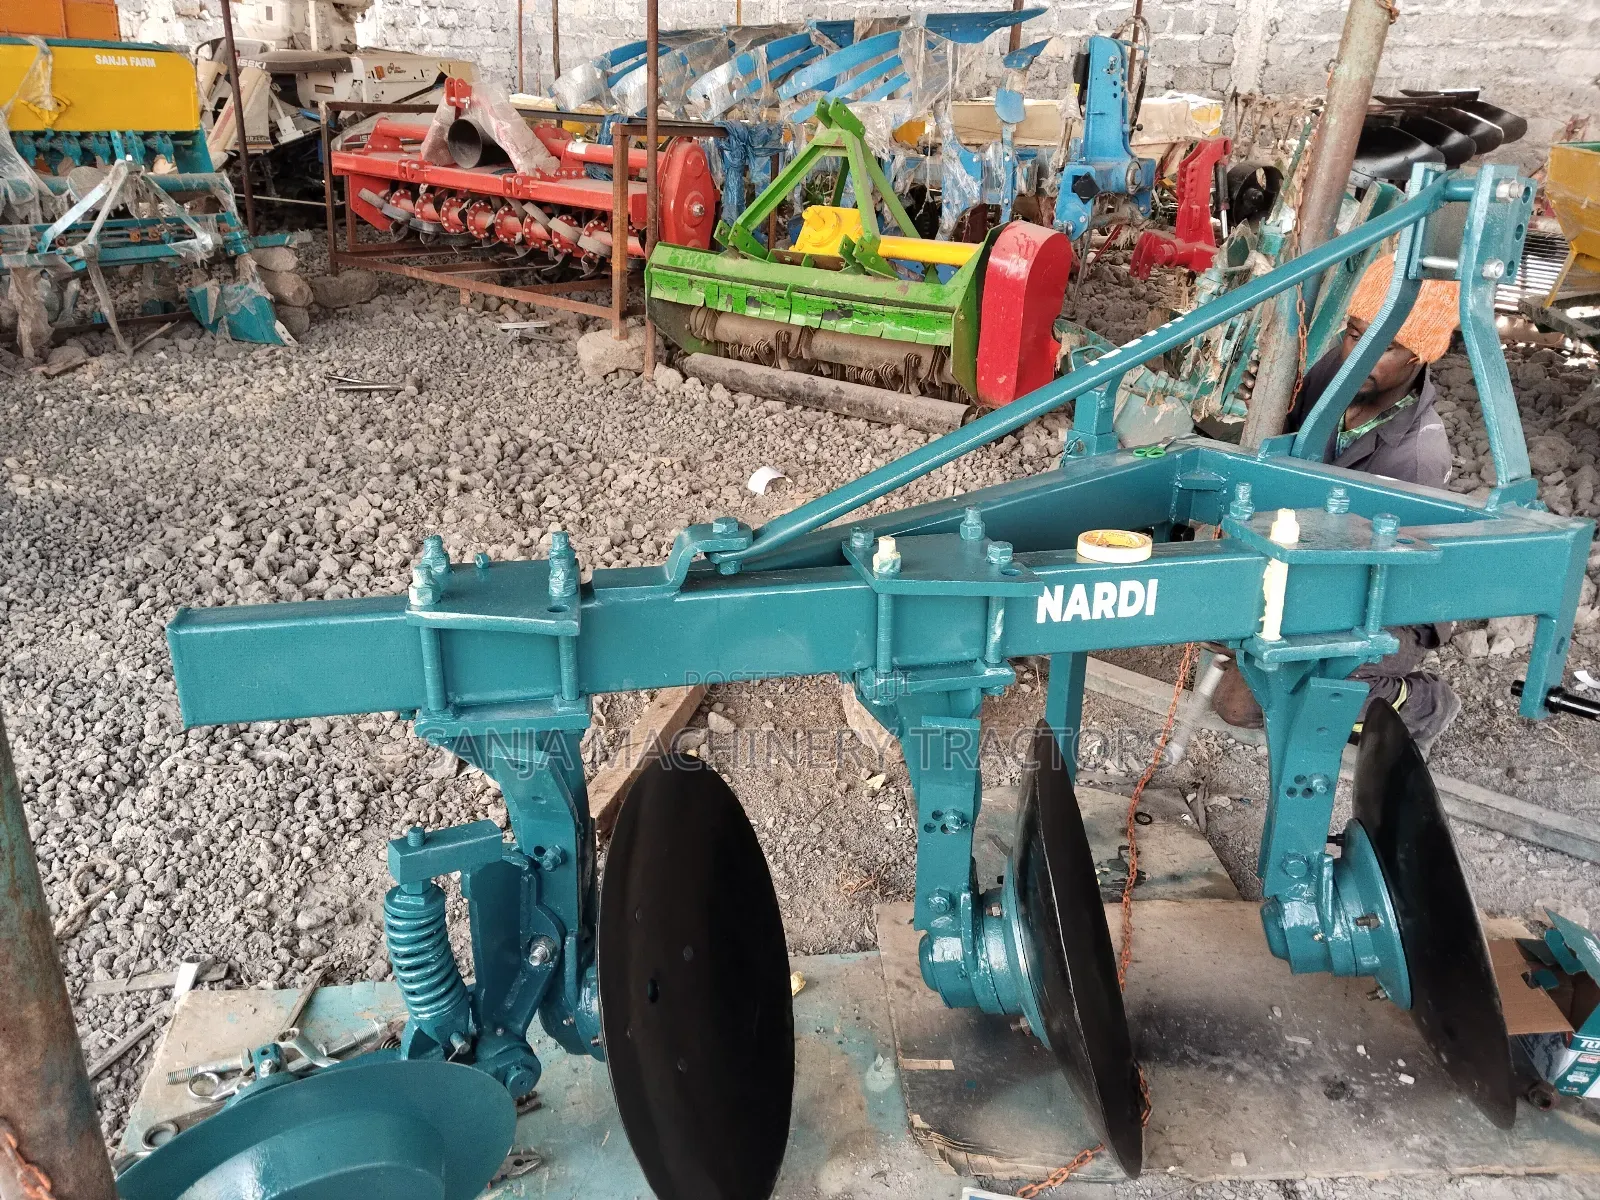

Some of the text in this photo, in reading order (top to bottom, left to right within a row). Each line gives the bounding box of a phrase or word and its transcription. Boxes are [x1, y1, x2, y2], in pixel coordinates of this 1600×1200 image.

[95, 54, 156, 68] SANJA FARM
[237, 58, 267, 70] ISEKI
[1036, 579, 1158, 623] NARDI
